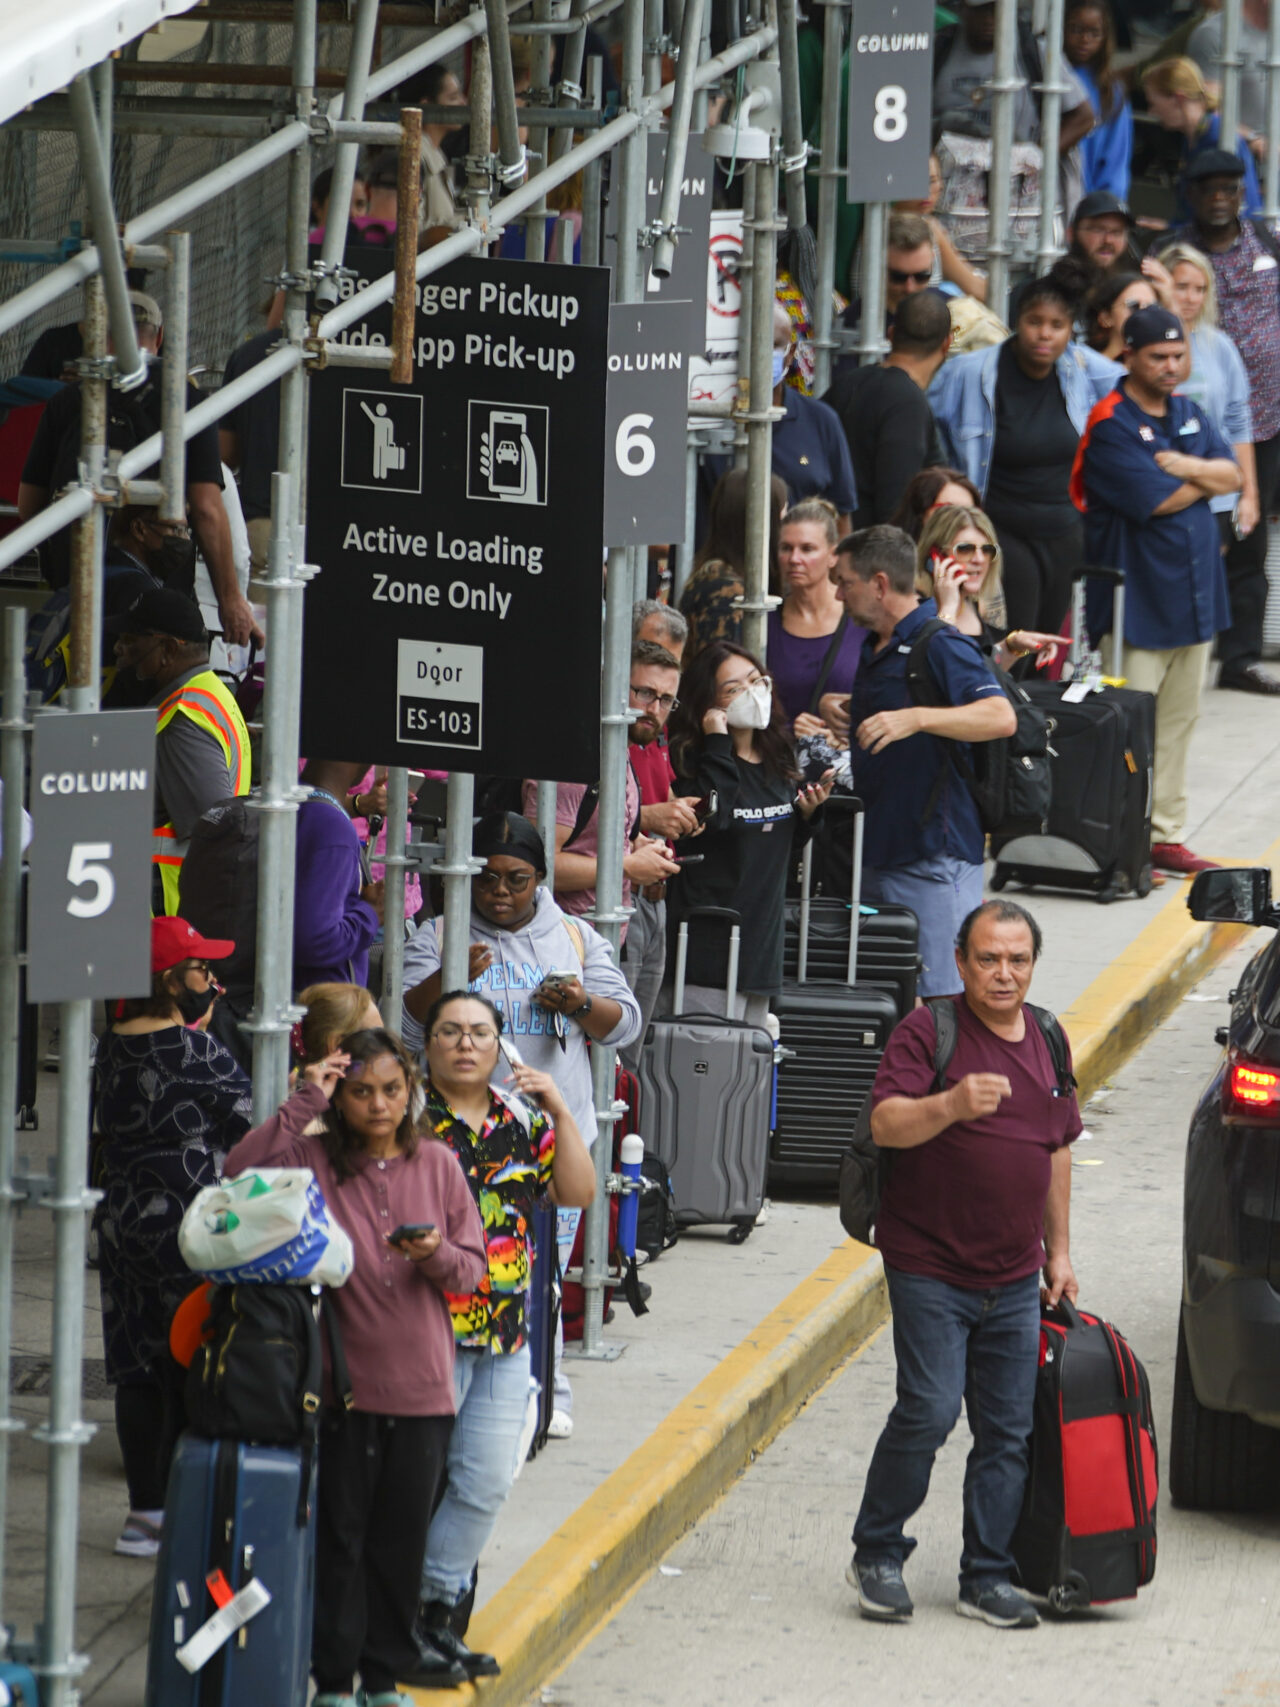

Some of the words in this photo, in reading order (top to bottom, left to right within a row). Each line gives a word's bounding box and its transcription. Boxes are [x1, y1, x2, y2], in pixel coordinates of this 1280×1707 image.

[857, 32, 930, 53] COLUMN
[873, 84, 908, 142] 8
[479, 282, 580, 327] Pickup
[411, 335, 456, 370] pp
[465, 334, 576, 380] Pick-up
[607, 352, 683, 372] OLUMN
[615, 413, 656, 476] 6
[342, 523, 428, 557] Active
[436, 531, 544, 575] Loading
[372, 573, 440, 606] Zone
[448, 581, 512, 619] Only
[416, 660, 463, 682] Door
[406, 707, 472, 735] ES-103
[40, 768, 148, 795] COLUMN
[733, 807, 763, 819] POLO
[66, 842, 116, 918] 5
